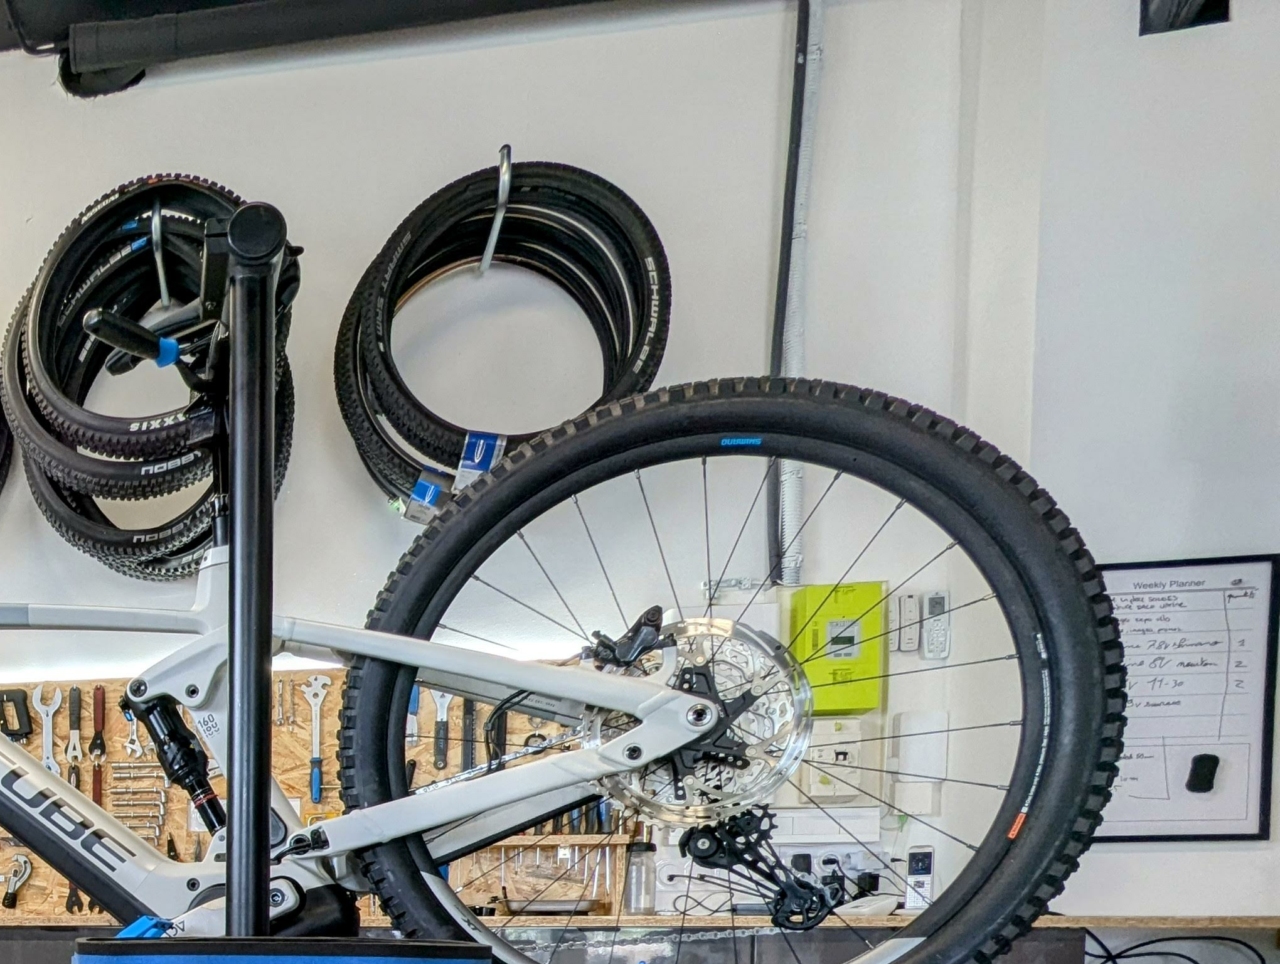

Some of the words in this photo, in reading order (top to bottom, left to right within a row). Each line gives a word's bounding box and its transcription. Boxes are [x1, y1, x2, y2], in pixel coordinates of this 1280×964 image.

[58, 245, 132, 327] SCHWALBE
[632, 257, 659, 374] SCHWALBE
[129, 411, 189, 432] AXXIS
[133, 515, 193, 543] NOBBY
[1133, 581, 1167, 590] Weekly
[1169, 580, 1206, 588] Planner
[198, 713, 215, 729] 160
